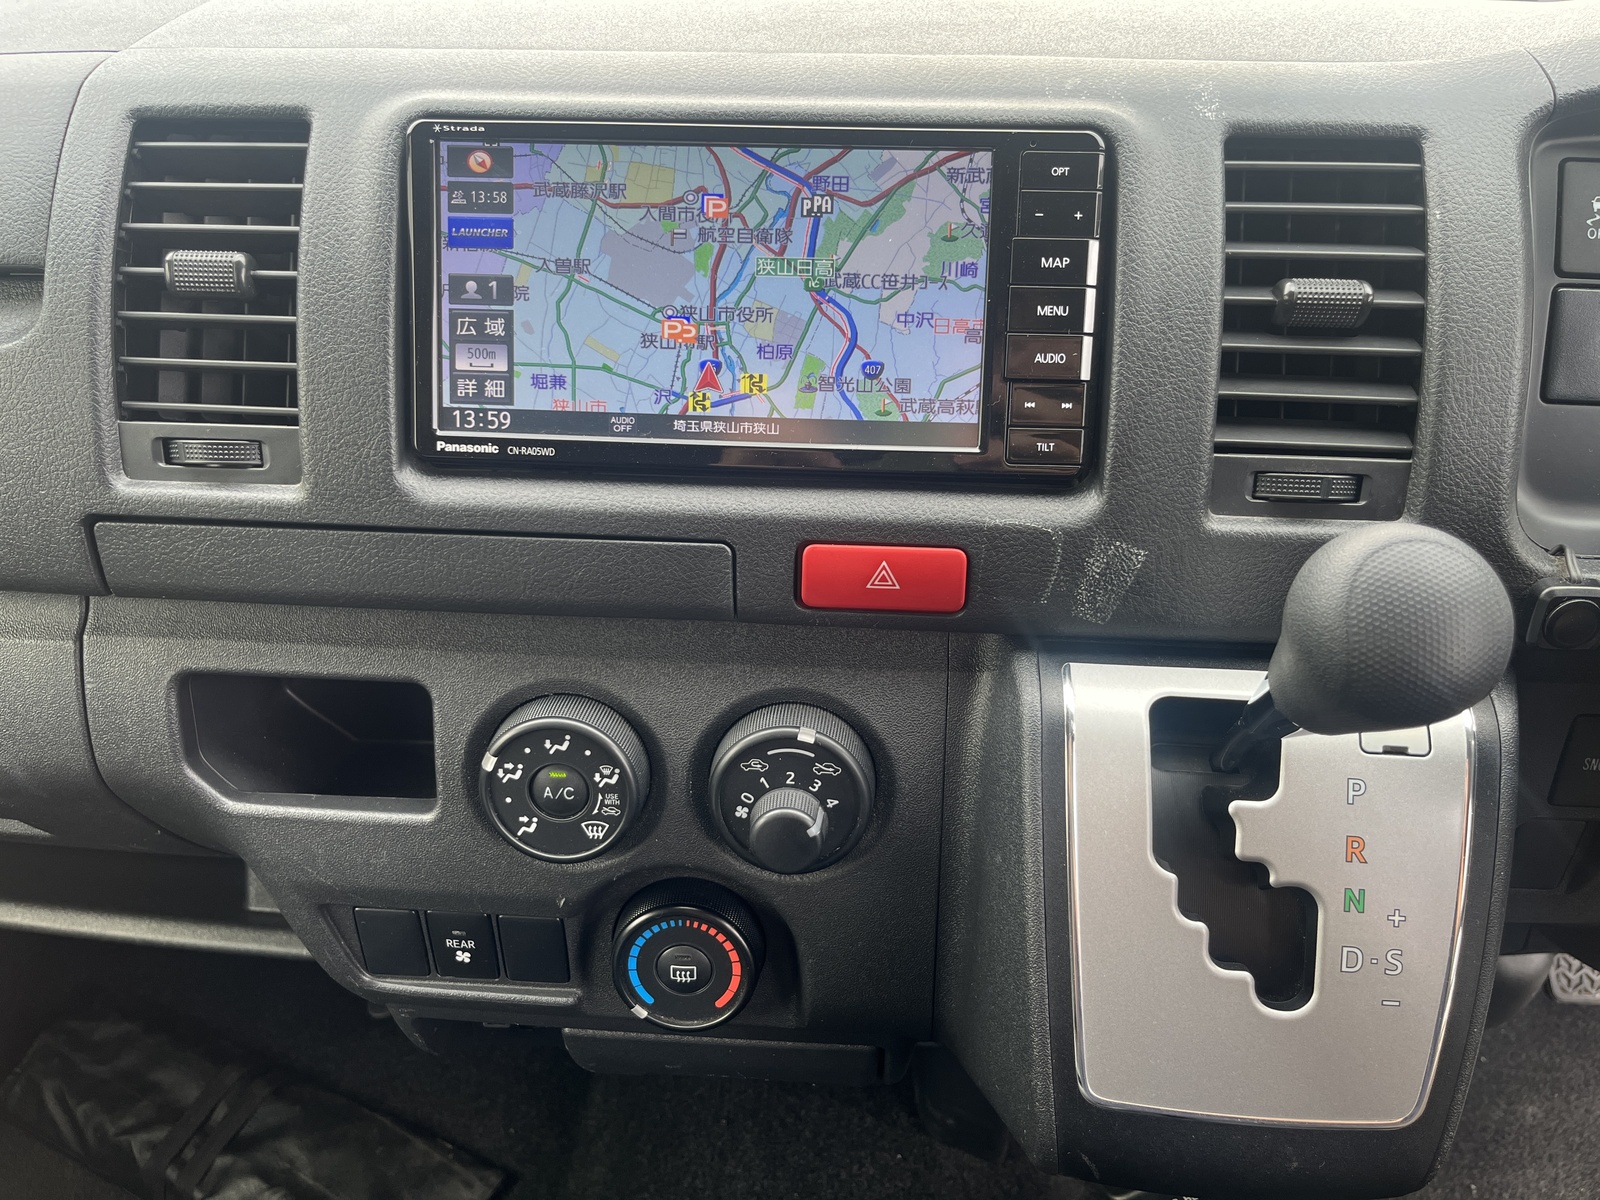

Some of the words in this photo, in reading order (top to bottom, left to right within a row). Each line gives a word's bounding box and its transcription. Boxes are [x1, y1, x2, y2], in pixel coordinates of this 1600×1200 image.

[1051, 167, 1070, 176] OPT
[533, 181, 627, 200] 武蔵藤沢駅
[812, 175, 849, 192] 野田
[470, 191, 508, 204] 13:58
[452, 227, 508, 237] LAUNCHER
[698, 227, 793, 244] 航空自衛隊
[757, 258, 835, 277] 狭山日高
[941, 261, 979, 279] 川崎
[1041, 257, 1071, 268] MAP
[488, 280, 498, 300] 1
[680, 305, 774, 323] 狭山市役所
[1037, 305, 1069, 317] MENU
[456, 317, 506, 337] 広域
[897, 311, 934, 329] 中沢
[467, 348, 496, 360] 500m
[757, 344, 793, 360] 柏原
[1034, 353, 1066, 364] AUDIO
[864, 366, 881, 375] 407
[457, 379, 505, 398] 詳細
[531, 373, 567, 390] 堀兼
[818, 376, 911, 394] 智光山公園
[654, 389, 672, 405] 沢
[899, 399, 980, 416] 武蔵高萩
[452, 410, 511, 429] 13:59
[610, 416, 635, 424] AUDIO
[673, 420, 780, 434] 埼玉県狭山市狭山
[436, 441, 500, 454] Panasonic
[507, 447, 556, 456] CN-RA05WD
[1036, 443, 1055, 452] TILT
[760, 776, 770, 789] 1
[785, 771, 795, 785] 2
[808, 779, 822, 792] 3
[543, 786, 575, 800] A/C
[740, 792, 755, 804] 0
[1346, 777, 1367, 805] P
[826, 798, 839, 808] 4
[1345, 835, 1368, 864] R
[1343, 888, 1365, 913] N
[445, 938, 476, 949] REAR
